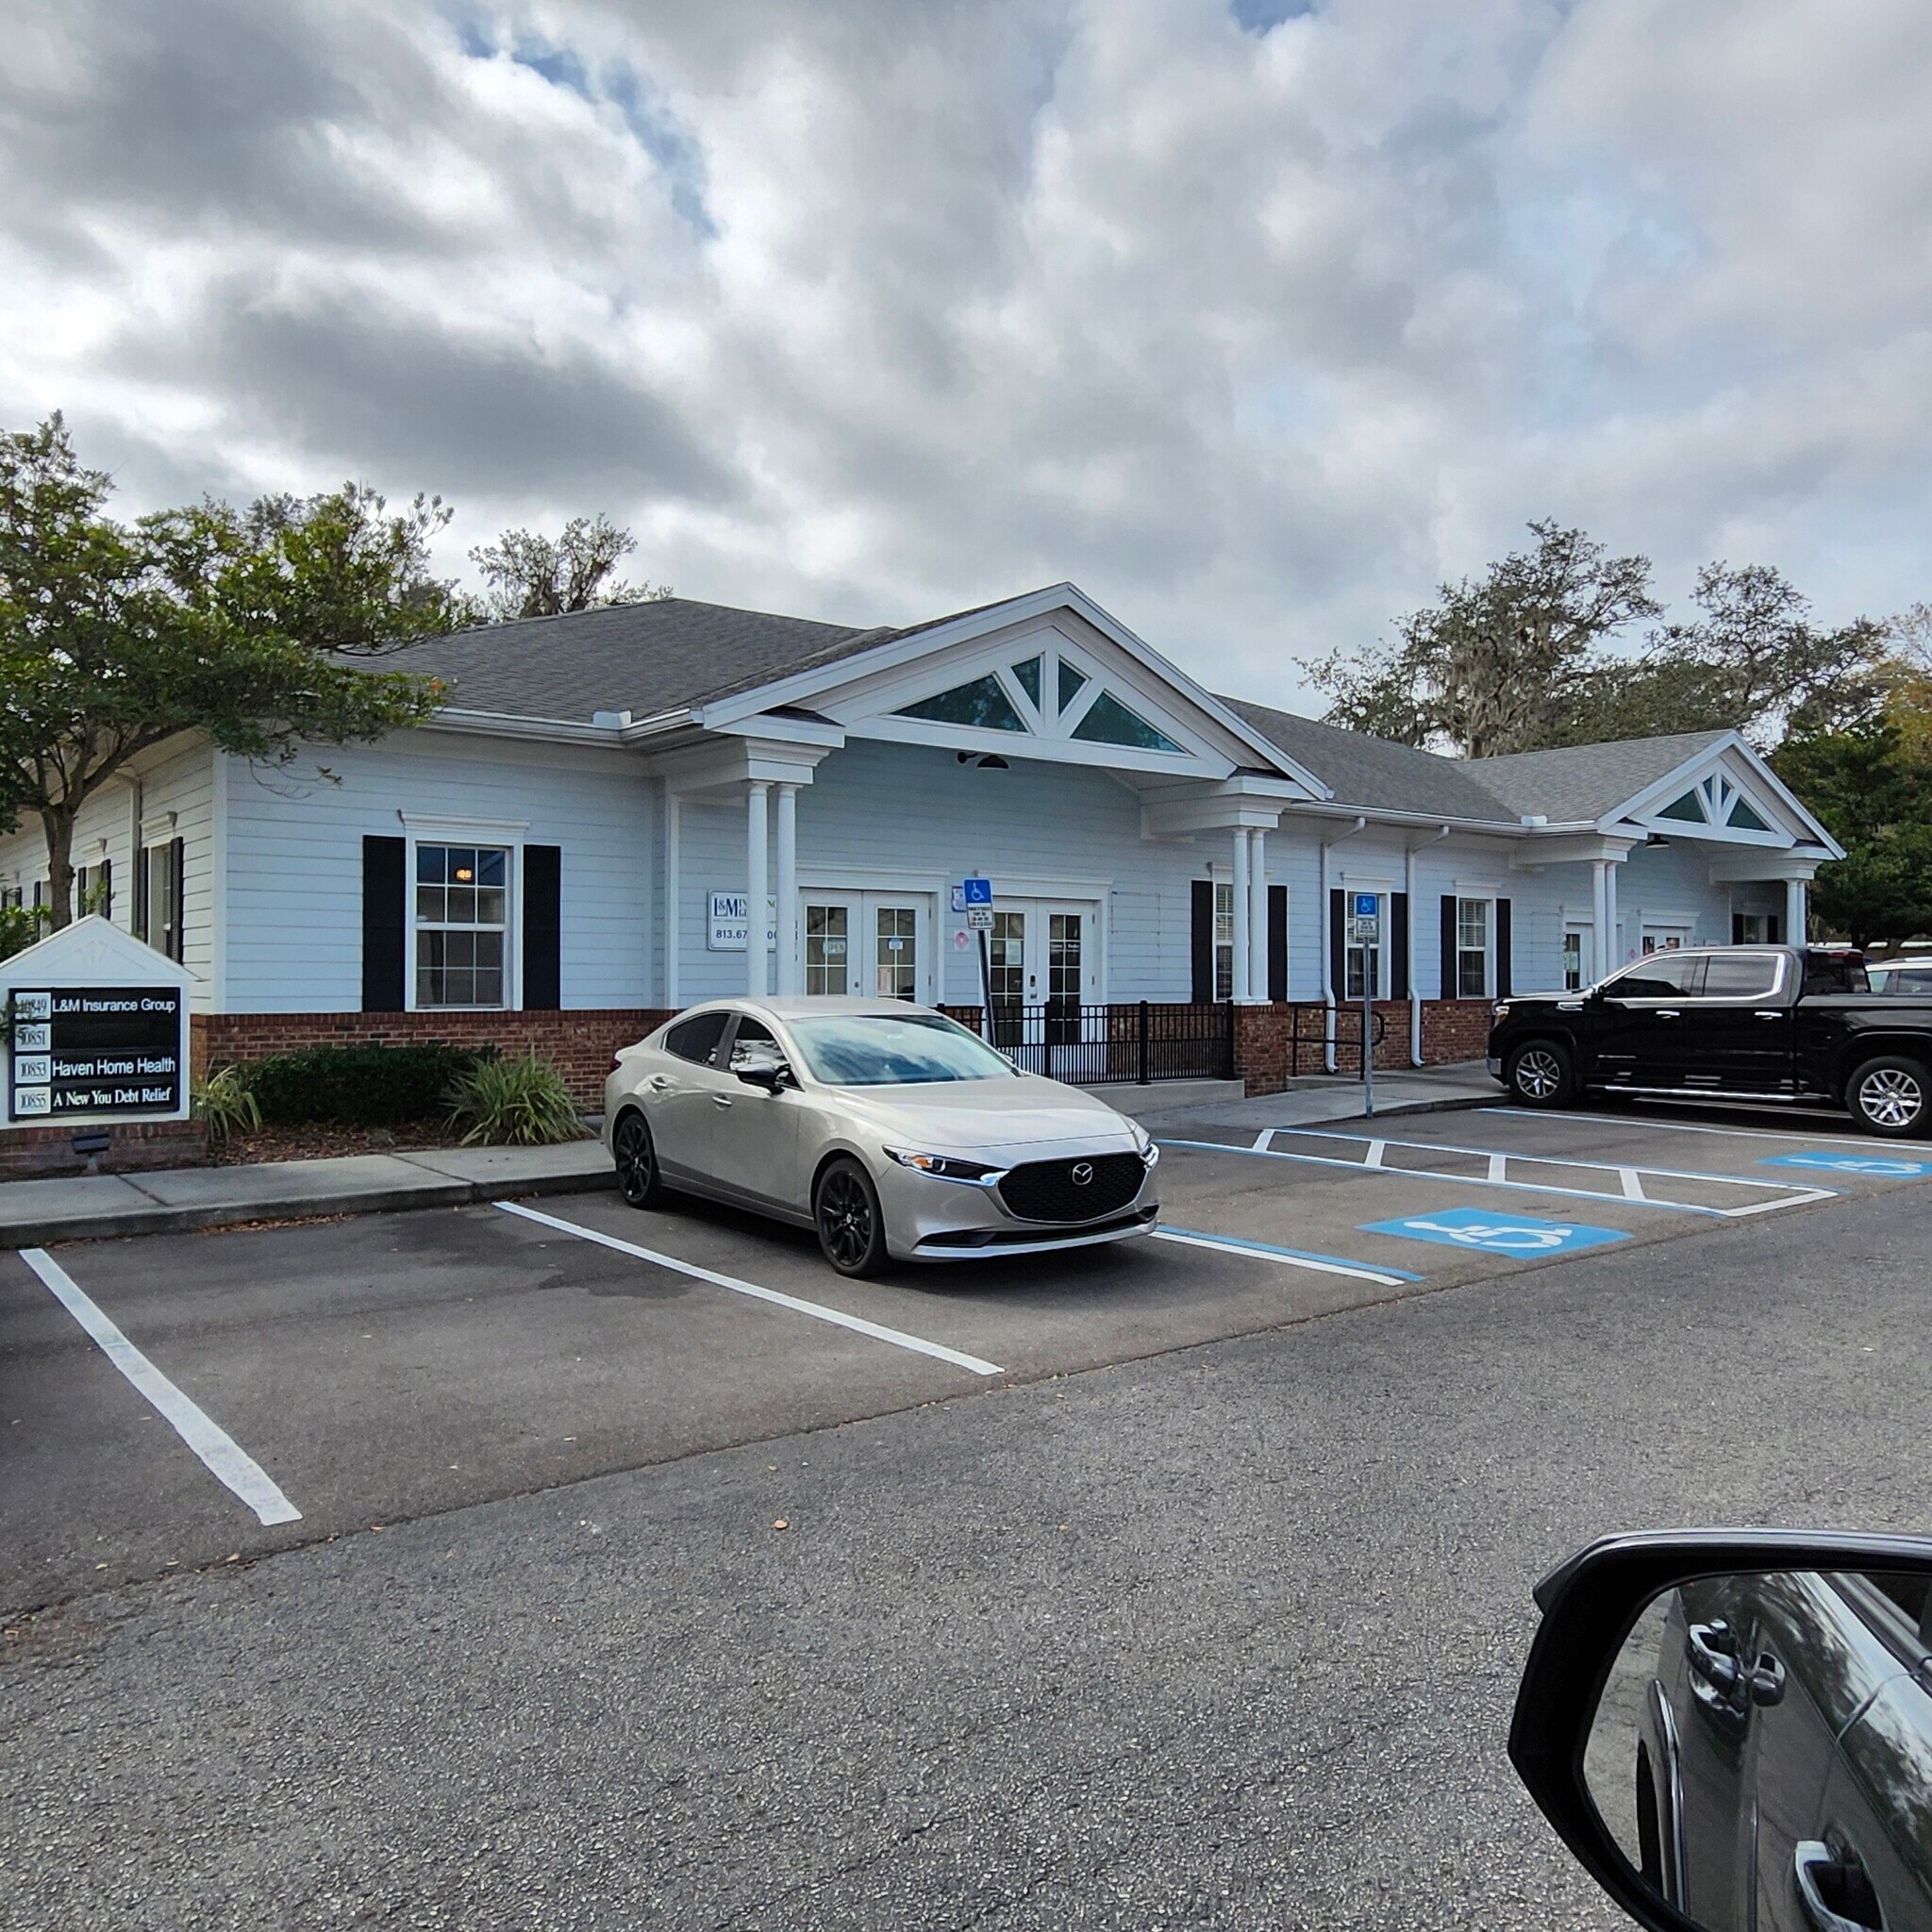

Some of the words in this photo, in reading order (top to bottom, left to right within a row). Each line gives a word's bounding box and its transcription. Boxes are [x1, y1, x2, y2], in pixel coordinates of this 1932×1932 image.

[714, 898, 738, 917] L&M
[52, 999, 80, 1012] L&M
[83, 999, 138, 1012] Insurance
[142, 998, 176, 1014] Group
[21, 1030, 45, 1045] 10851
[21, 1061, 46, 1077] 10853
[52, 1060, 94, 1077] Haven
[97, 1058, 134, 1075] Home
[137, 1057, 175, 1074] Health
[21, 1093, 46, 1108] 10855
[53, 1092, 63, 1108] A
[66, 1091, 90, 1107] New
[92, 1091, 111, 1105] You
[114, 1089, 140, 1104] Debt
[142, 1087, 172, 1102] Relief
